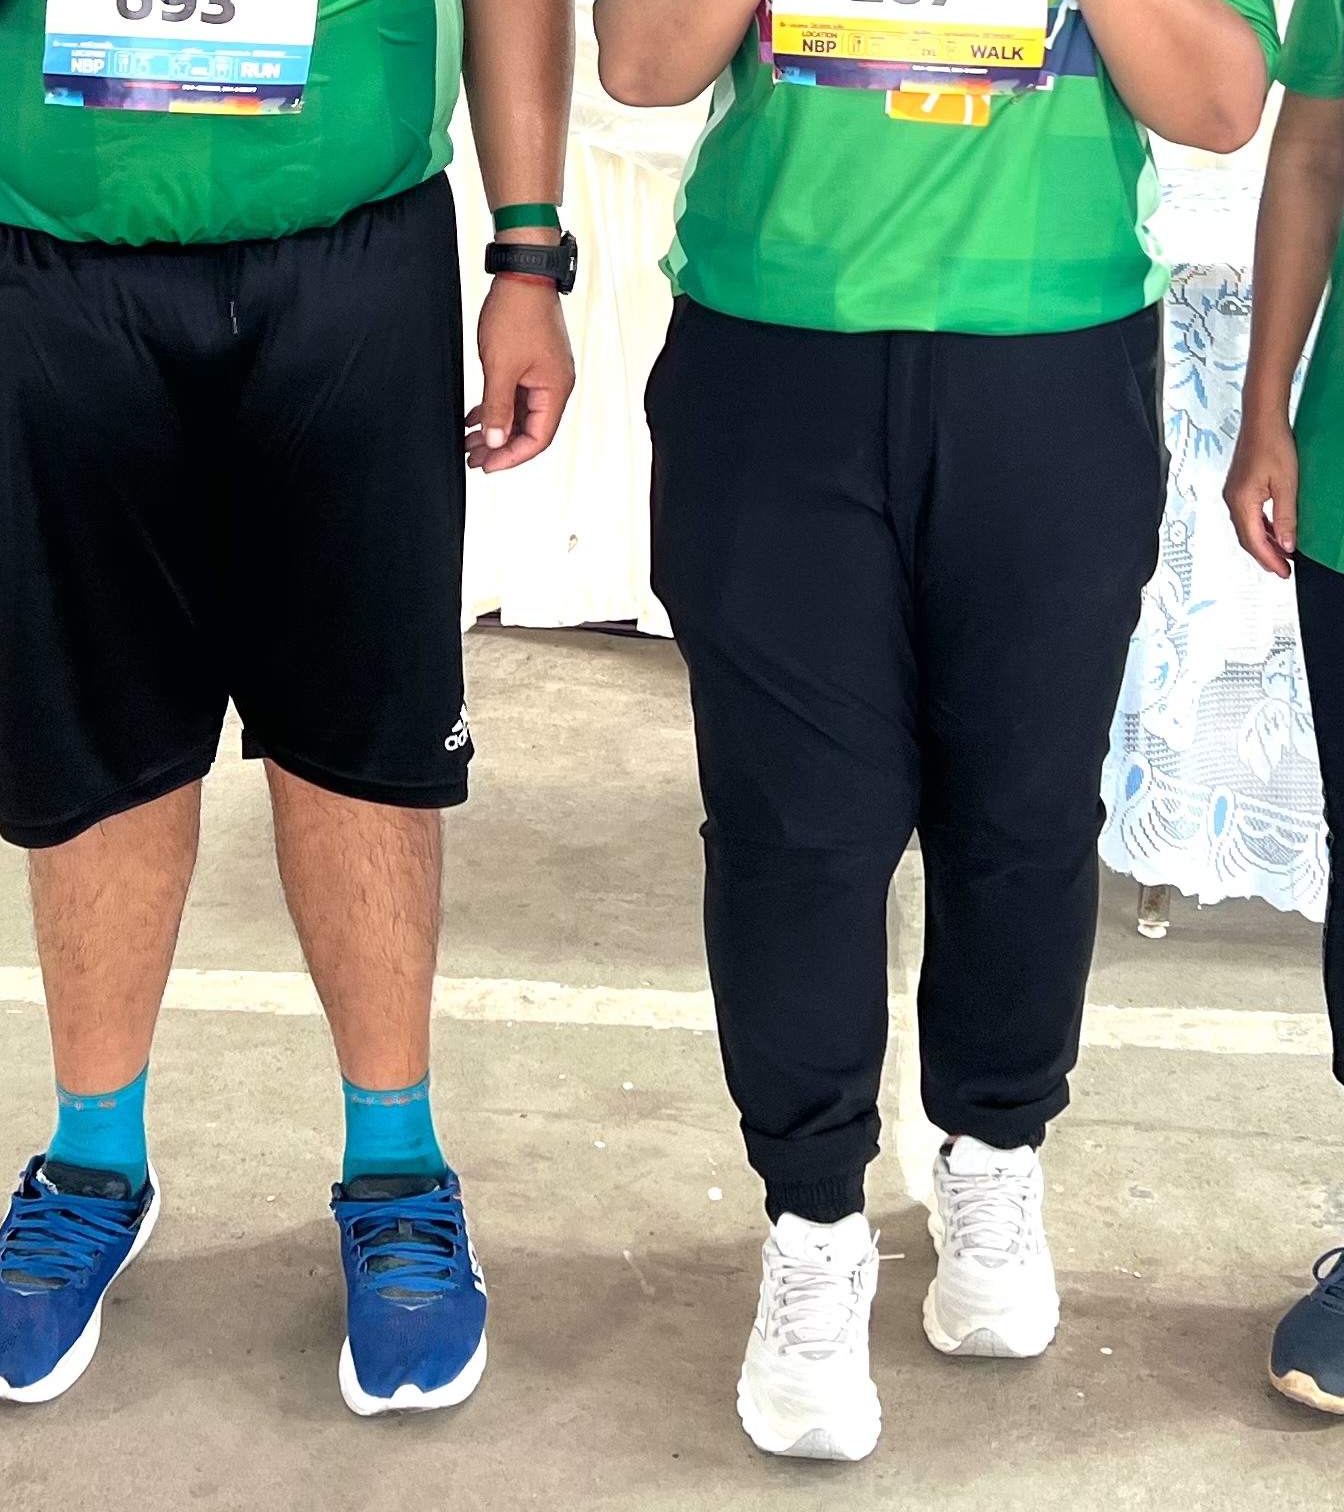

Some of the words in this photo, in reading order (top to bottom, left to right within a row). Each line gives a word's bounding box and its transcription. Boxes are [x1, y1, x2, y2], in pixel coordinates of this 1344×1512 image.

[802, 31, 838, 39] LOCATION
[802, 39, 837, 54] NBP
[971, 44, 1024, 61] WALK
[71, 58, 105, 74] NBP
[241, 63, 281, 79] RUN
